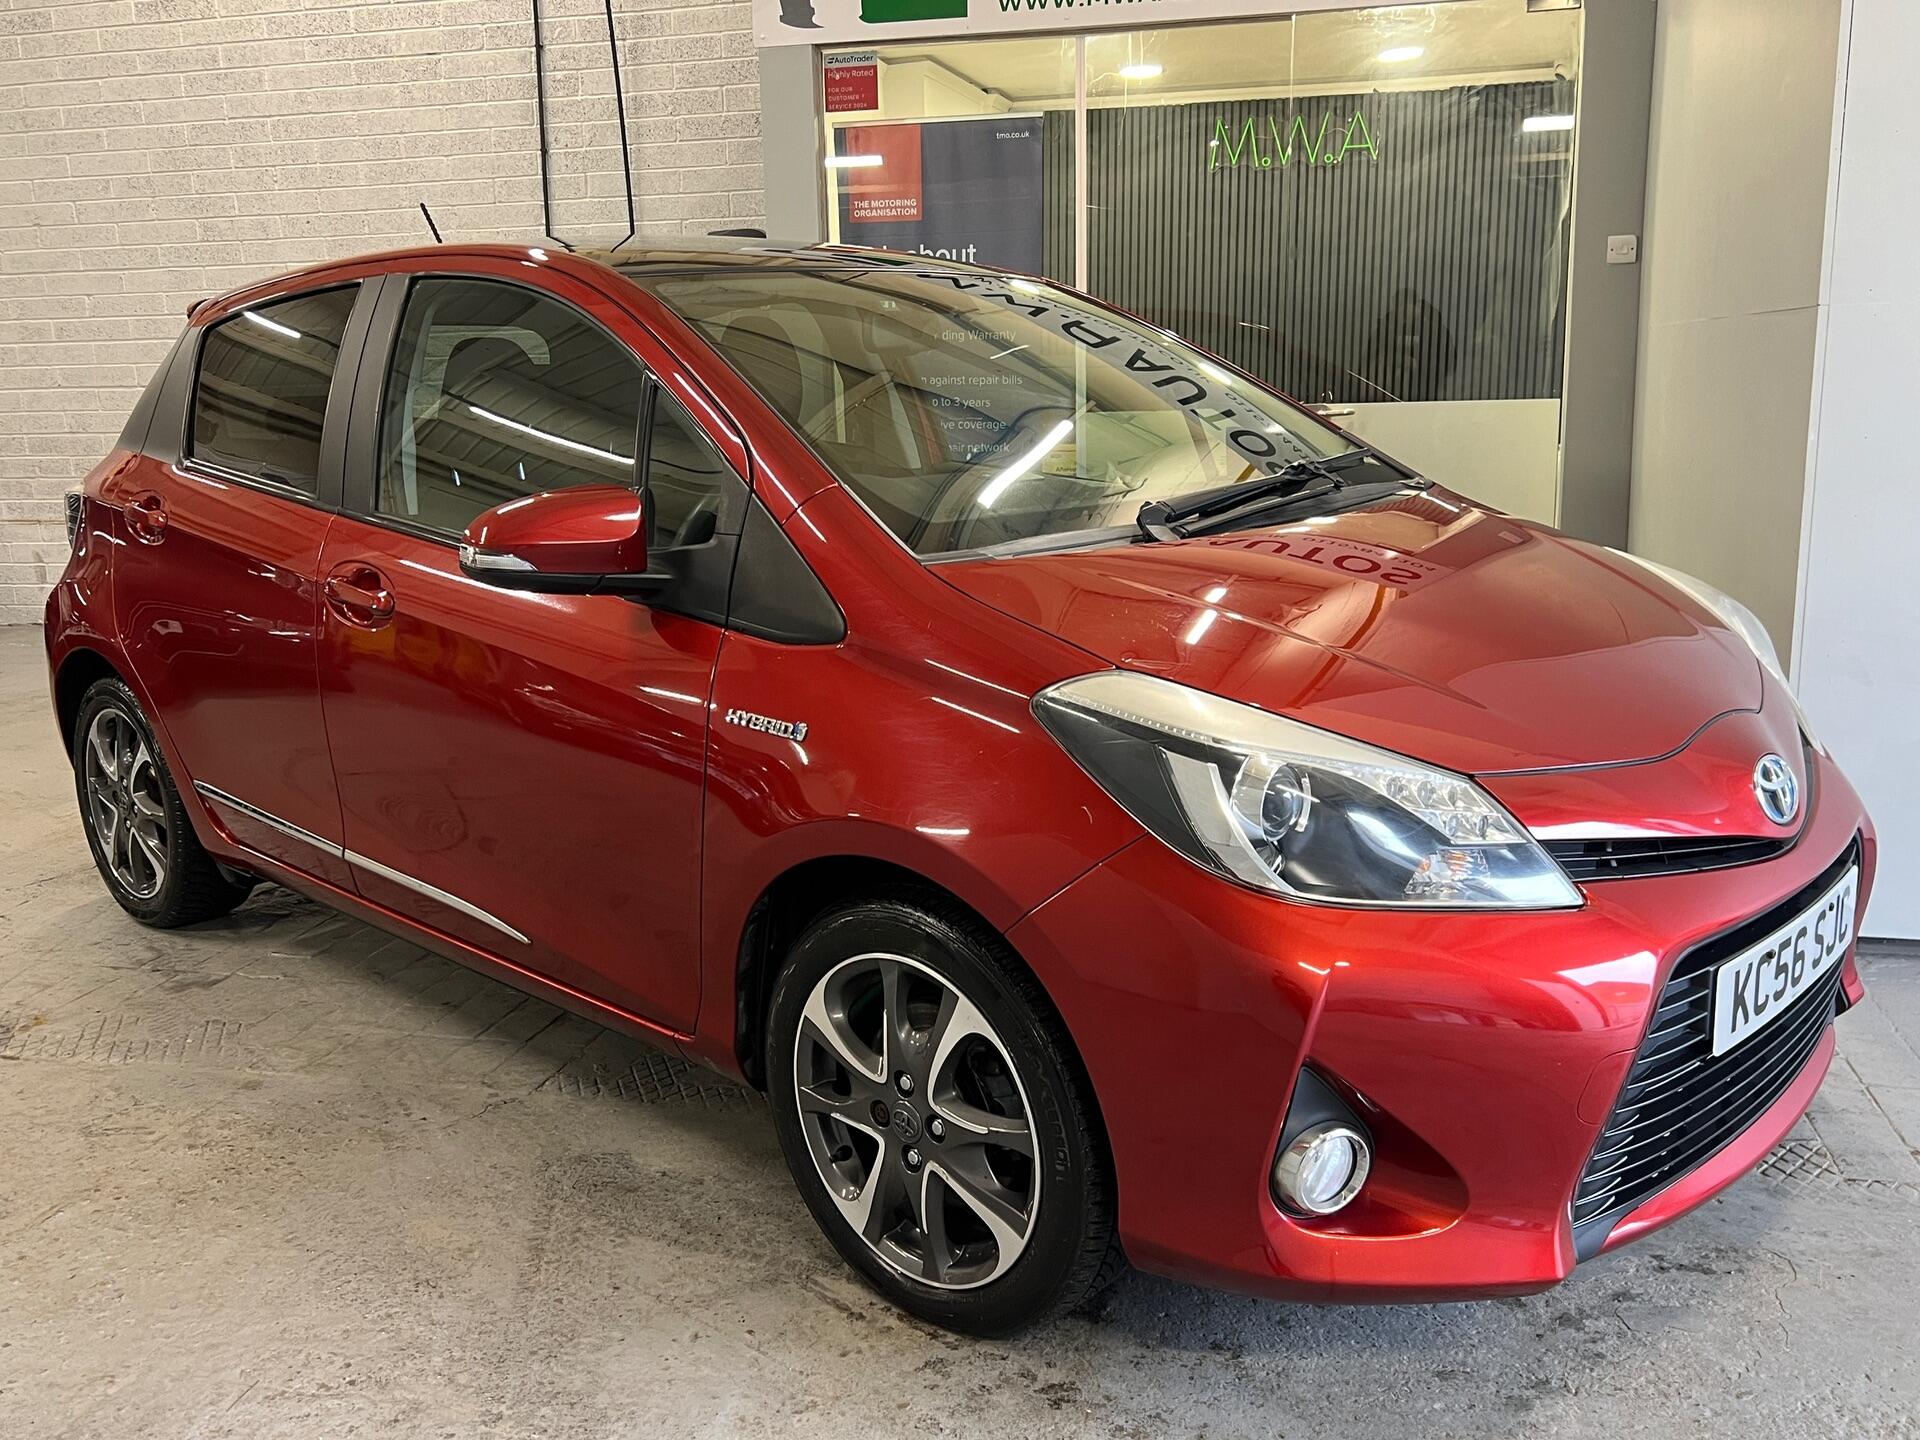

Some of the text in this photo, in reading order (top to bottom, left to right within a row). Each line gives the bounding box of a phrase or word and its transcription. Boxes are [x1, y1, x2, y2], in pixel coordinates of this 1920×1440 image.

[834, 55, 874, 64] AutoTrader
[827, 68, 874, 80] Highly Rated
[996, 131, 1030, 140] tmo.co.uk
[1211, 111, 1378, 170] M.W.A
[871, 198, 917, 208] MOTORING
[854, 208, 917, 218] ORGANISATION
[907, 244, 977, 264] bout
[968, 329, 1016, 342] Warranty
[930, 375, 966, 387] against
[968, 375, 1000, 387] repair
[1002, 375, 1023, 385] bills
[941, 397, 951, 407] to
[953, 396, 960, 407] 3
[962, 399, 991, 409] years
[958, 420, 1007, 432] coverage
[967, 442, 1011, 453] network
[725, 708, 794, 738] HYBRID
[1731, 885, 1851, 1033] KC56 SJC
